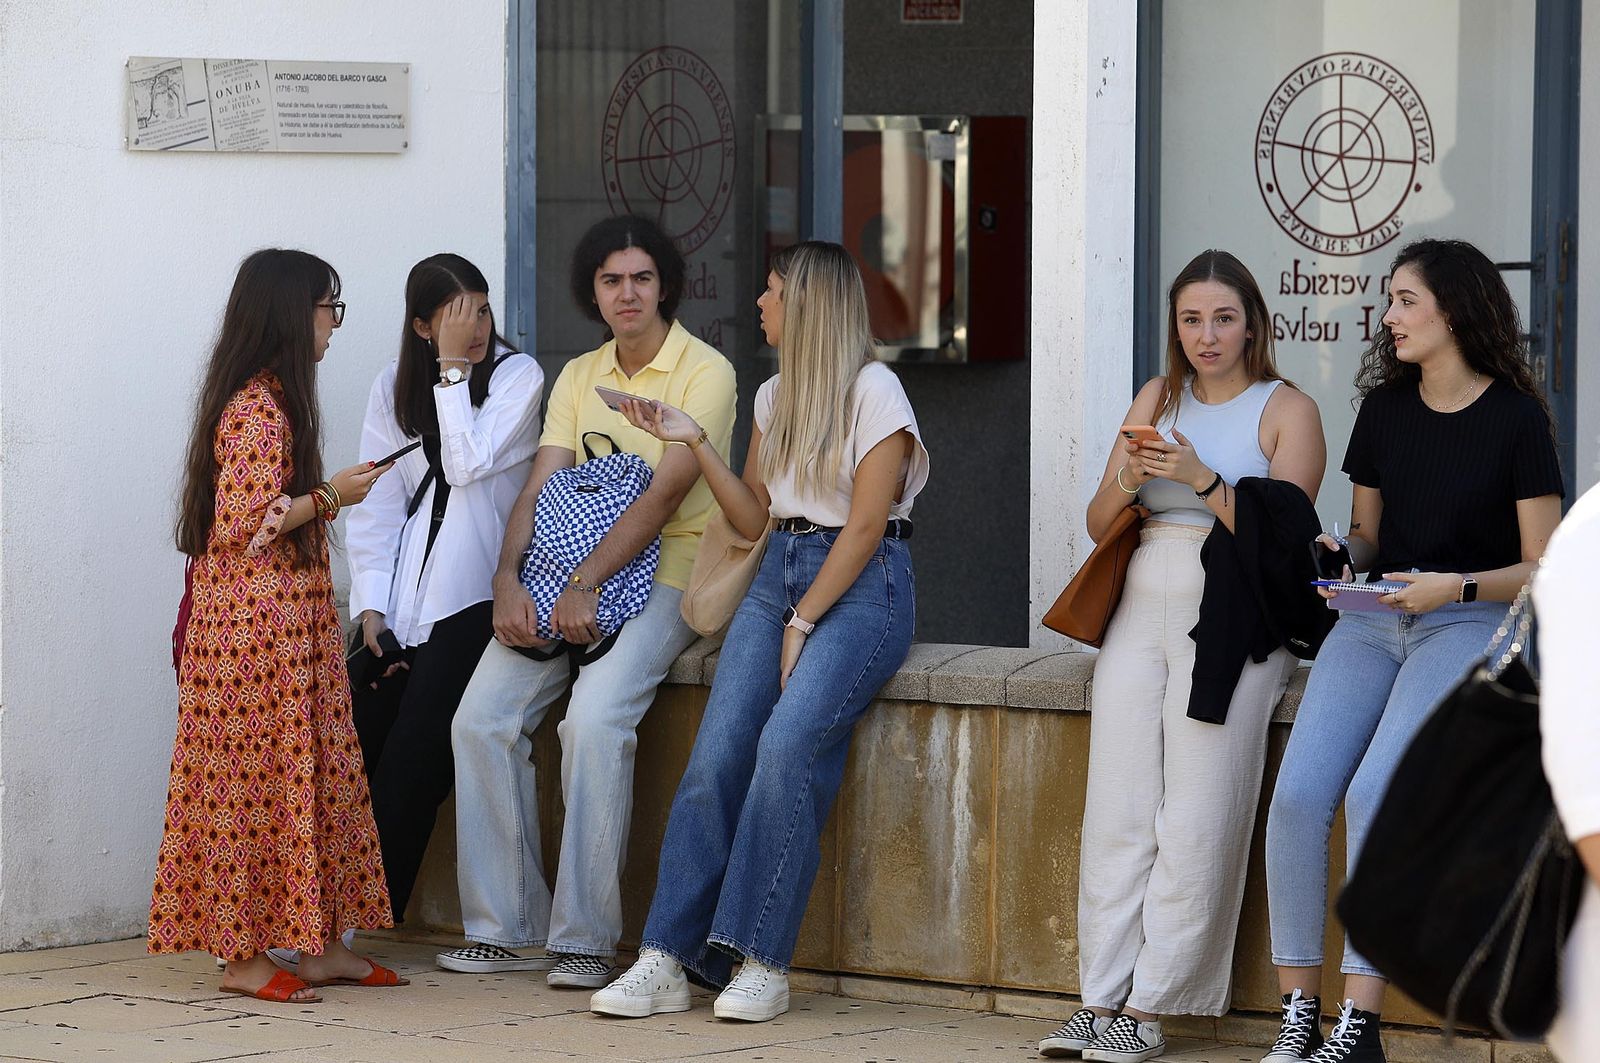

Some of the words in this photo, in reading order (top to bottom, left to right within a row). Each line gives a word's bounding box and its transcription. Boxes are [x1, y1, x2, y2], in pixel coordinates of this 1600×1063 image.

[275, 73, 301, 81] ANTONIO
[328, 74, 339, 82] DEL
[340, 74, 361, 82] BARCO
[362, 74, 366, 82] Y
[215, 80, 261, 99] ONUBA
